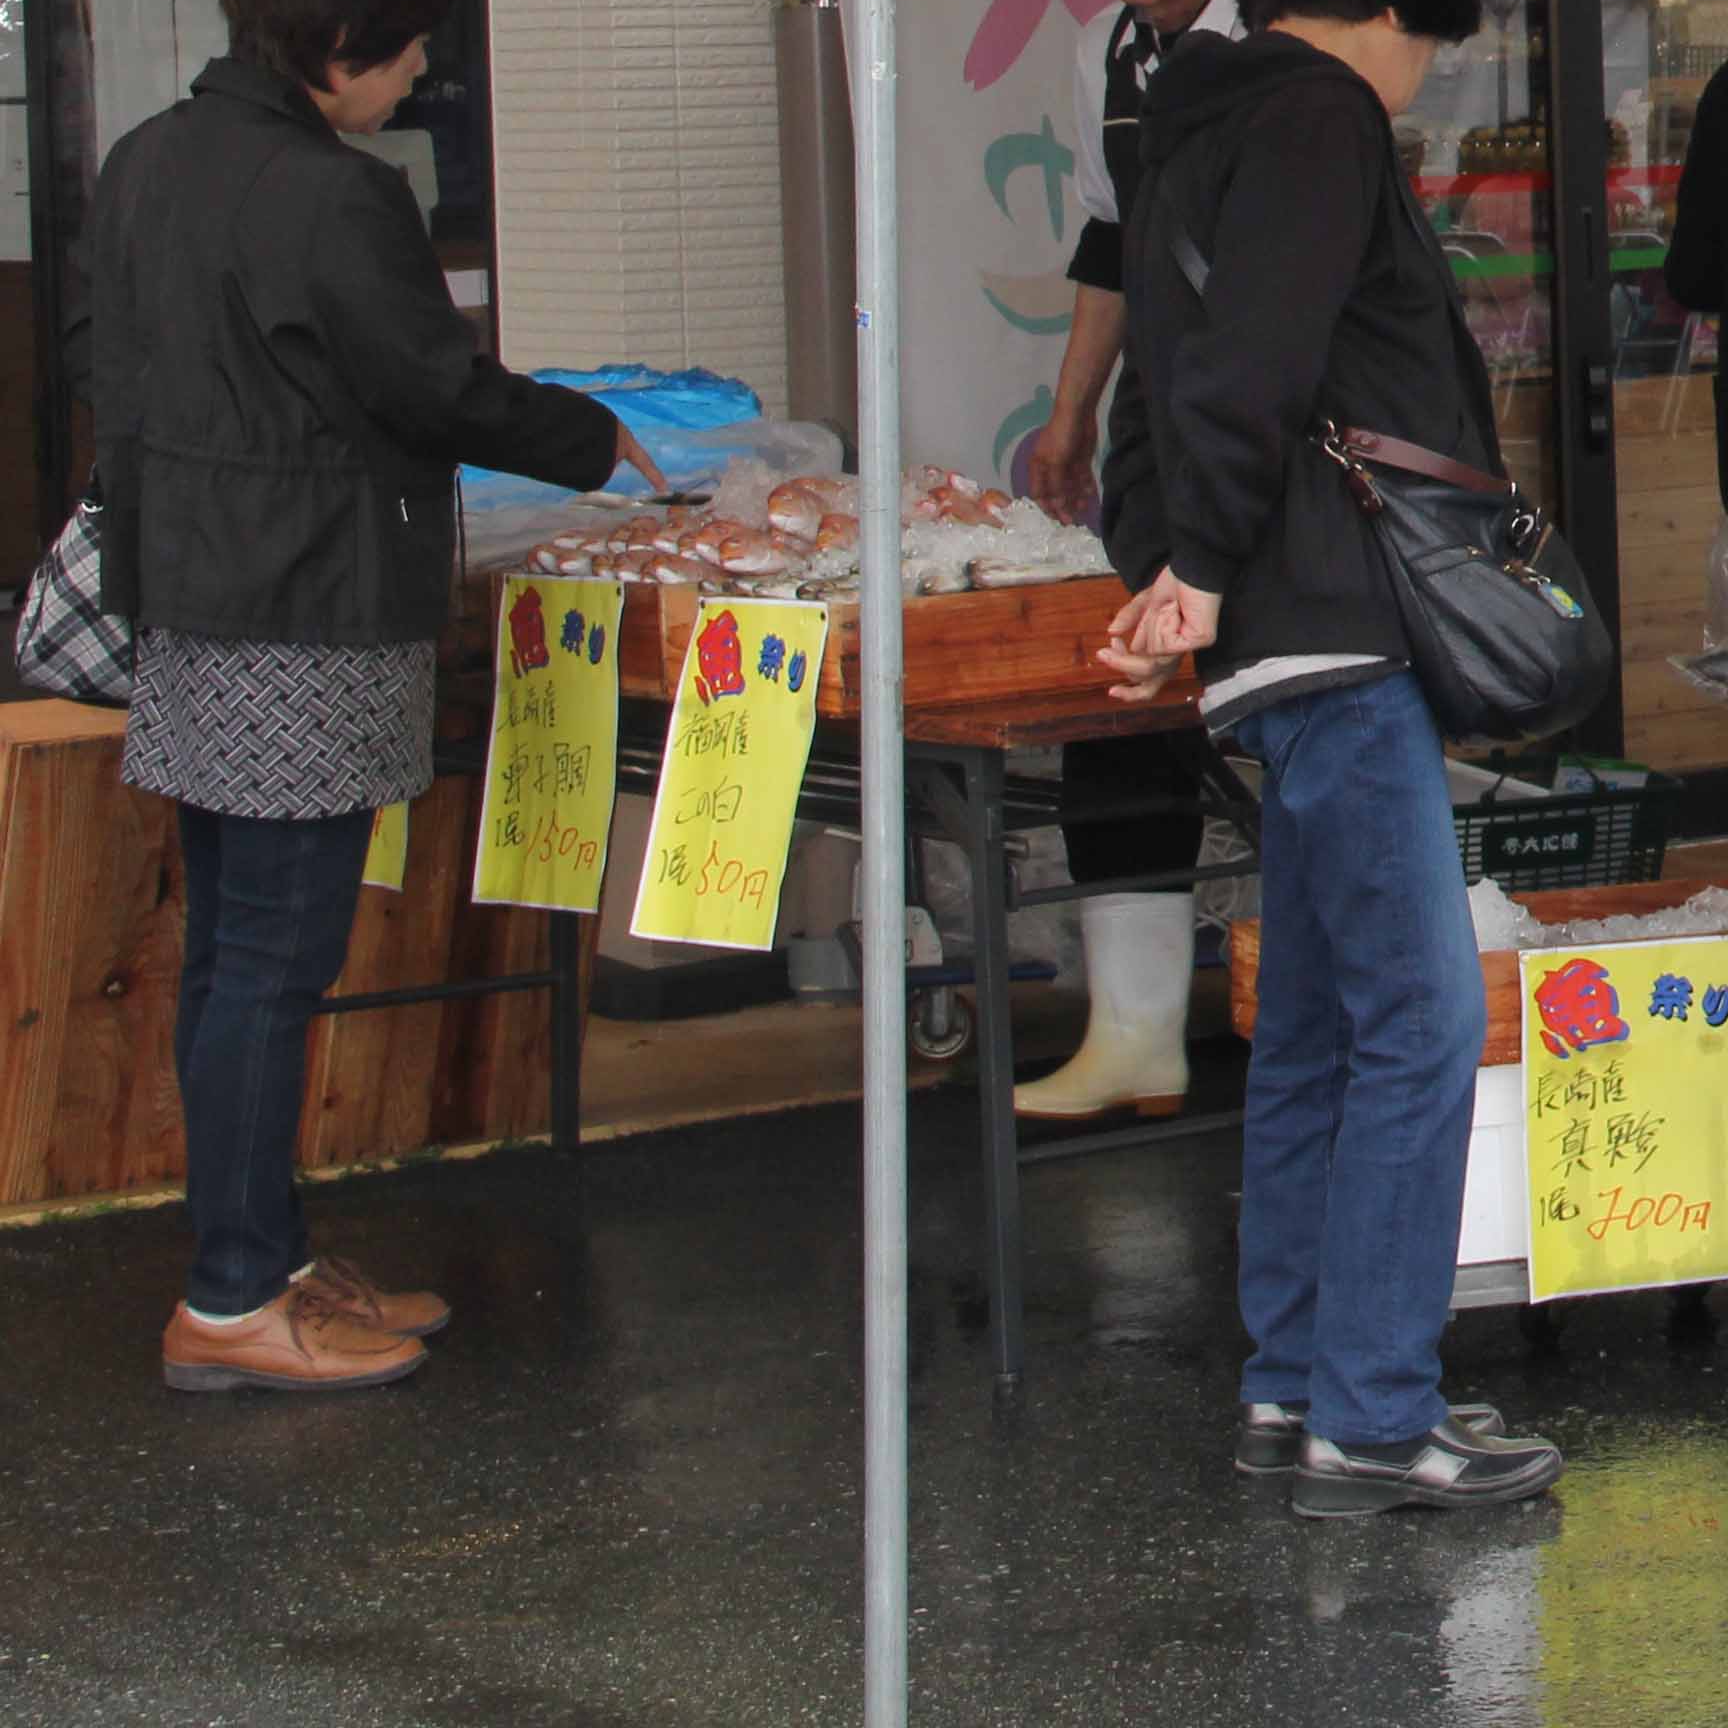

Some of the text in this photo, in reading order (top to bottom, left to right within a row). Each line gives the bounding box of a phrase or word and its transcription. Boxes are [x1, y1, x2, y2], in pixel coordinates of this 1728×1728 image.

[561, 608, 605, 665] 祭り
[758, 634, 806, 692] 祭り
[1534, 958, 1631, 1059] 魚
[1530, 1059, 1629, 1119] 長崎産
